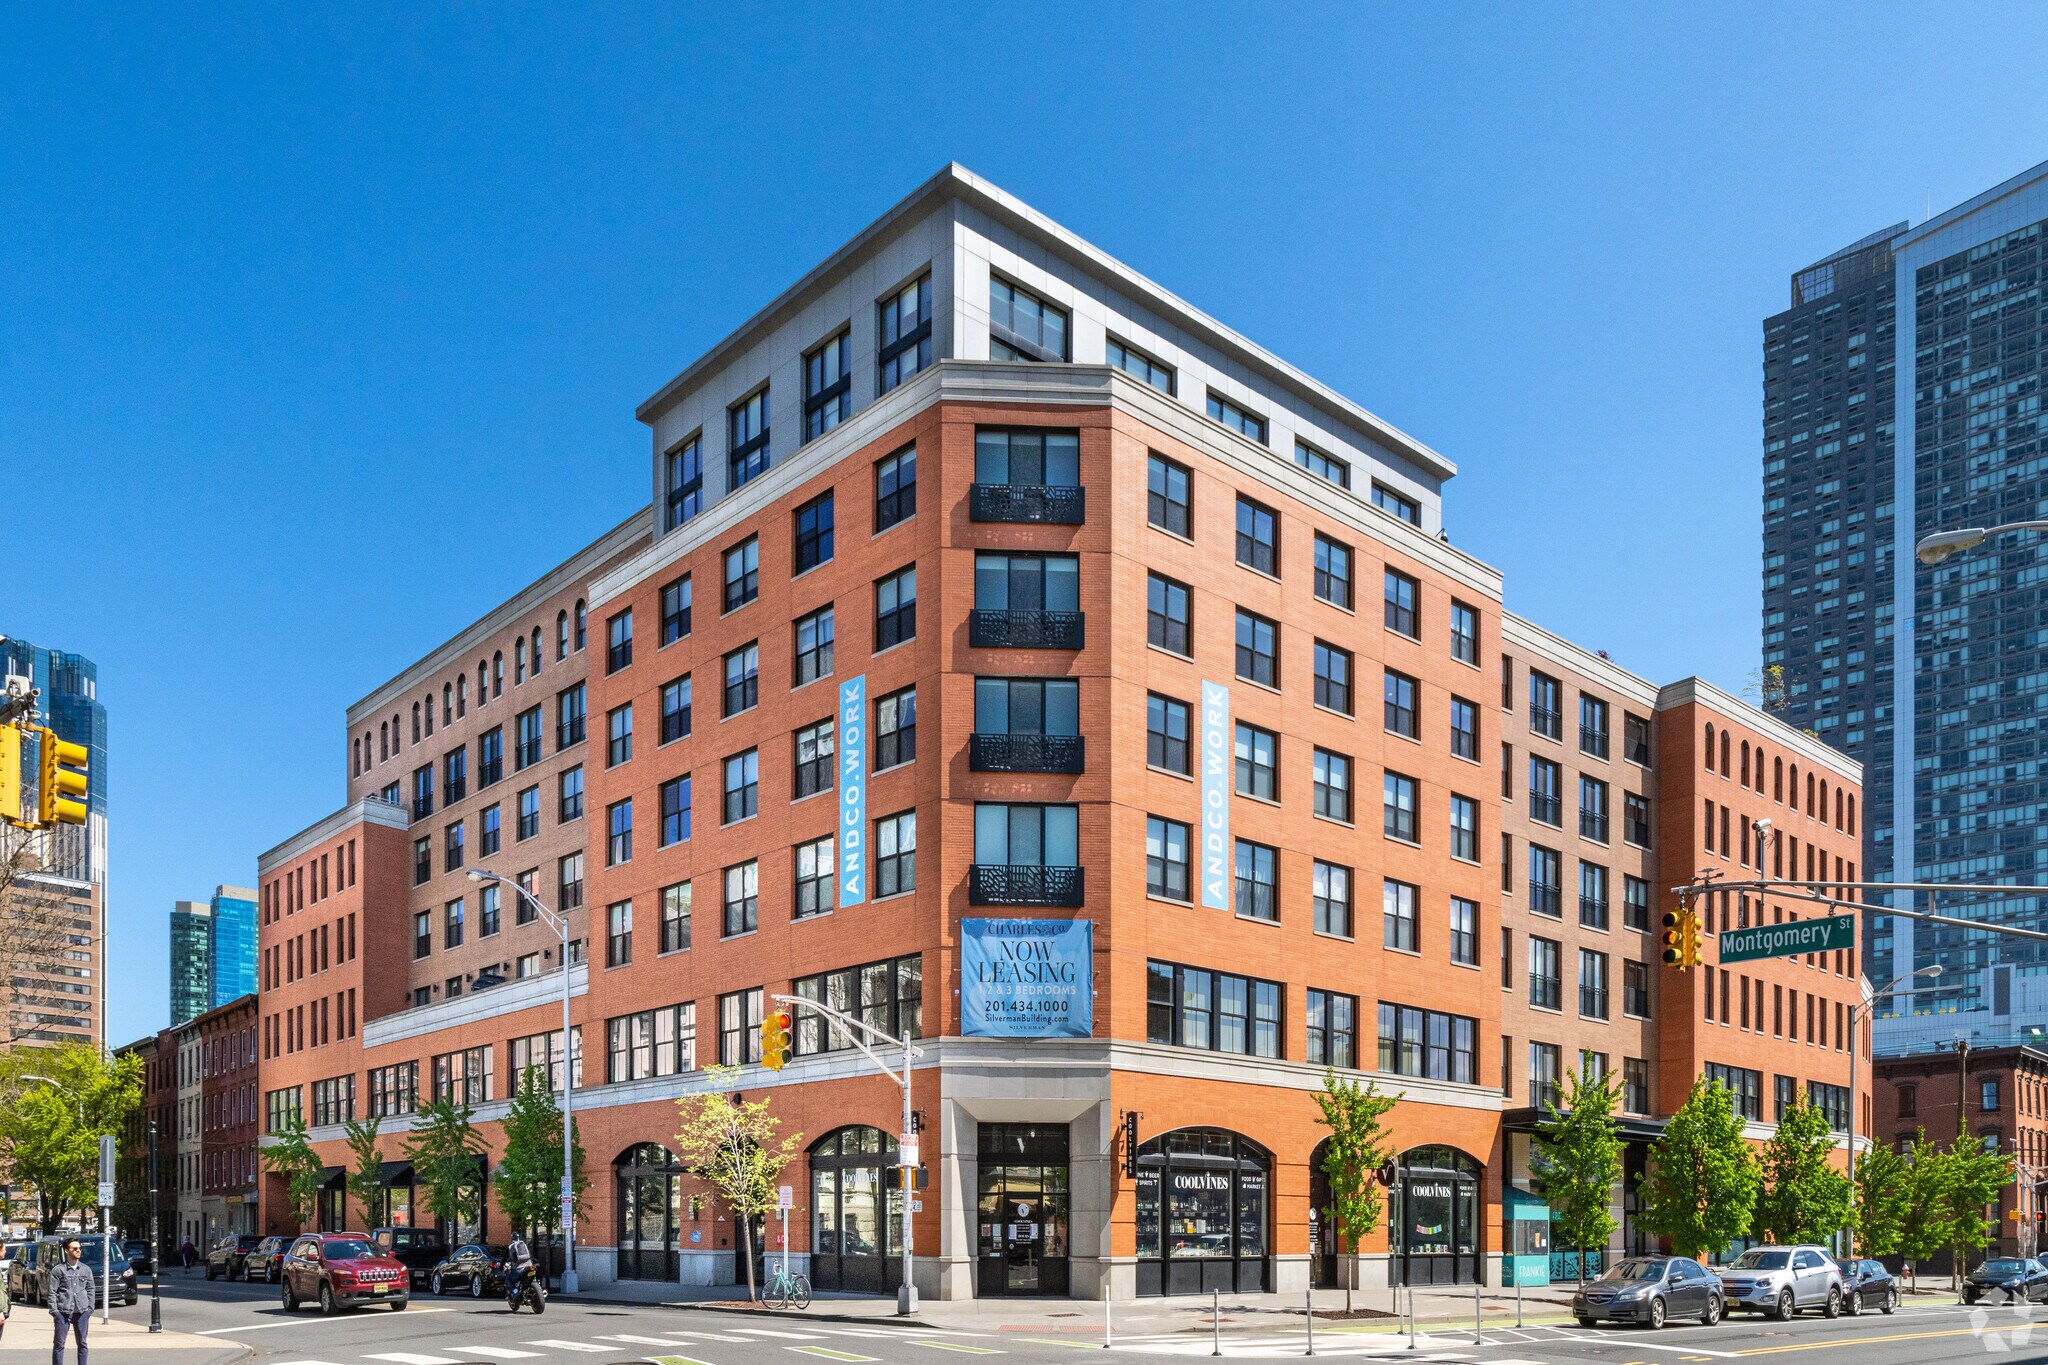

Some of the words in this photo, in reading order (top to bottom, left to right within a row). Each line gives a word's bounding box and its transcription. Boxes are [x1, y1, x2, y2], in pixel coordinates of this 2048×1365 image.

[845, 682, 860, 895] ANDCO.WORK
[1207, 687, 1223, 901] ANDCO.WORK
[988, 924, 1041, 935] CHARLES
[1721, 924, 1832, 955] Montgomery
[1839, 918, 1851, 930] St
[1000, 941, 1055, 961] NOW
[978, 962, 1076, 983] LEASING
[1006, 985, 1012, 995] 3
[1015, 985, 1077, 995] BEDROOMS
[985, 1000, 1069, 1012] 201.434.1000
[985, 1013, 1069, 1025] SilvermanBuilding.com
[1174, 1171, 1229, 1190] COOLVINES
[1412, 1182, 1451, 1198] COOLVINES
[1519, 1265, 1546, 1278] FRANKIE
